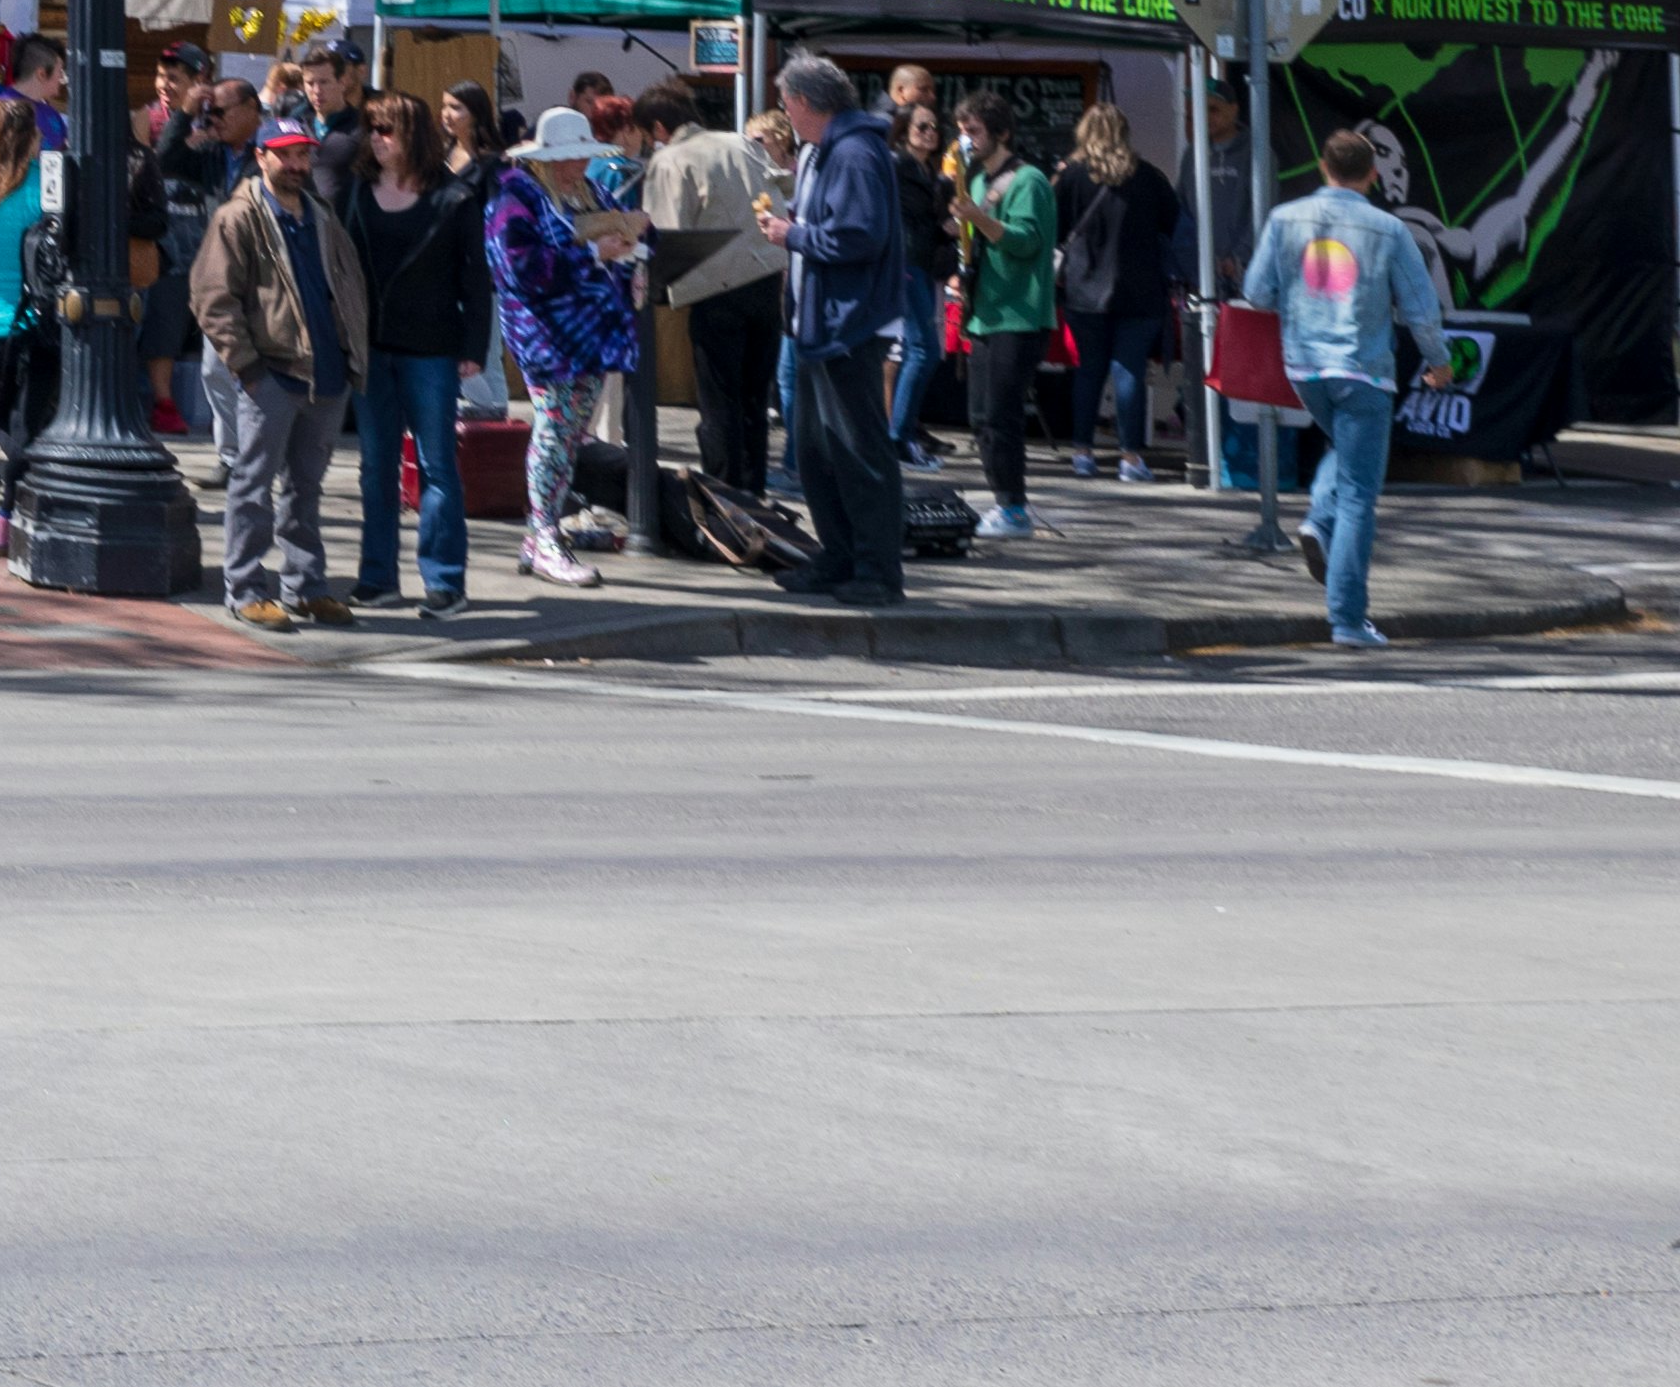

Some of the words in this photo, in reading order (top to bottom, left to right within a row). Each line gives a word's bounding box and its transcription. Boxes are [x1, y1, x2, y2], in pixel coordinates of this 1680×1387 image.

[1562, 0, 1605, 30] THE
[1611, 3, 1666, 33] CORE
[1395, 389, 1472, 434] AVID
